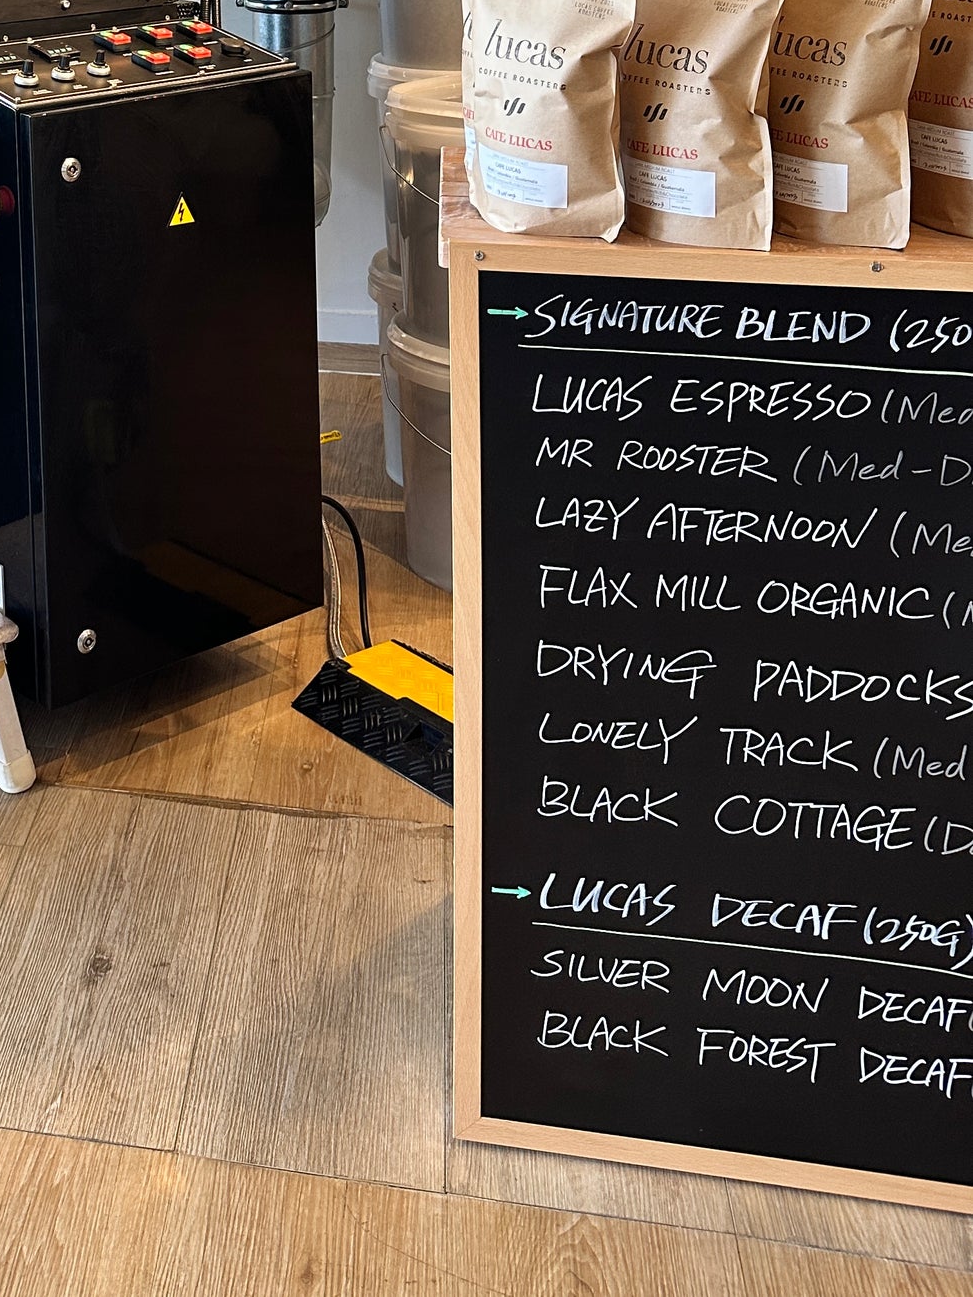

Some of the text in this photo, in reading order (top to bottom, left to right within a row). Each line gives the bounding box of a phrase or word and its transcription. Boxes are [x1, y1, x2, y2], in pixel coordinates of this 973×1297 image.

[484, 18, 567, 70] lucas
[623, 22, 710, 74] lucas
[478, 66, 567, 91] COFFEE ROASTERS
[655, 79, 711, 96] ROASTERS
[791, 70, 848, 88] ROASTERS
[485, 126, 553, 151] CAFE LUCAS
[652, 144, 698, 160] LUCAS
[786, 131, 829, 149] LUCAS
[524, 293, 725, 341] SIGNATURE
[735, 307, 871, 344] BLEND
[531, 374, 653, 421] LUCAS
[670, 379, 872, 423] ESPRESSO
[535, 437, 594, 470] MR
[617, 440, 779, 484] ROOSTER
[535, 496, 640, 541] LAZY
[646, 502, 878, 550] AFTERNOON
[539, 564, 638, 610] FLAX
[655, 573, 742, 612] MILL
[757, 579, 936, 621] ORGANIC
[536, 639, 718, 700] DRYING
[537, 712, 698, 765] LONELY
[719, 726, 859, 772] TRACK
[536, 774, 680, 827] BLACK
[714, 793, 917, 852] COTTAGE
[537, 871, 677, 928] LUCAS
[710, 892, 859, 941] DECAF
[529, 949, 671, 995] SILVER
[702, 968, 830, 1014] MOON
[536, 1009, 670, 1058] BLACK
[696, 1026, 837, 1084] FOREST
